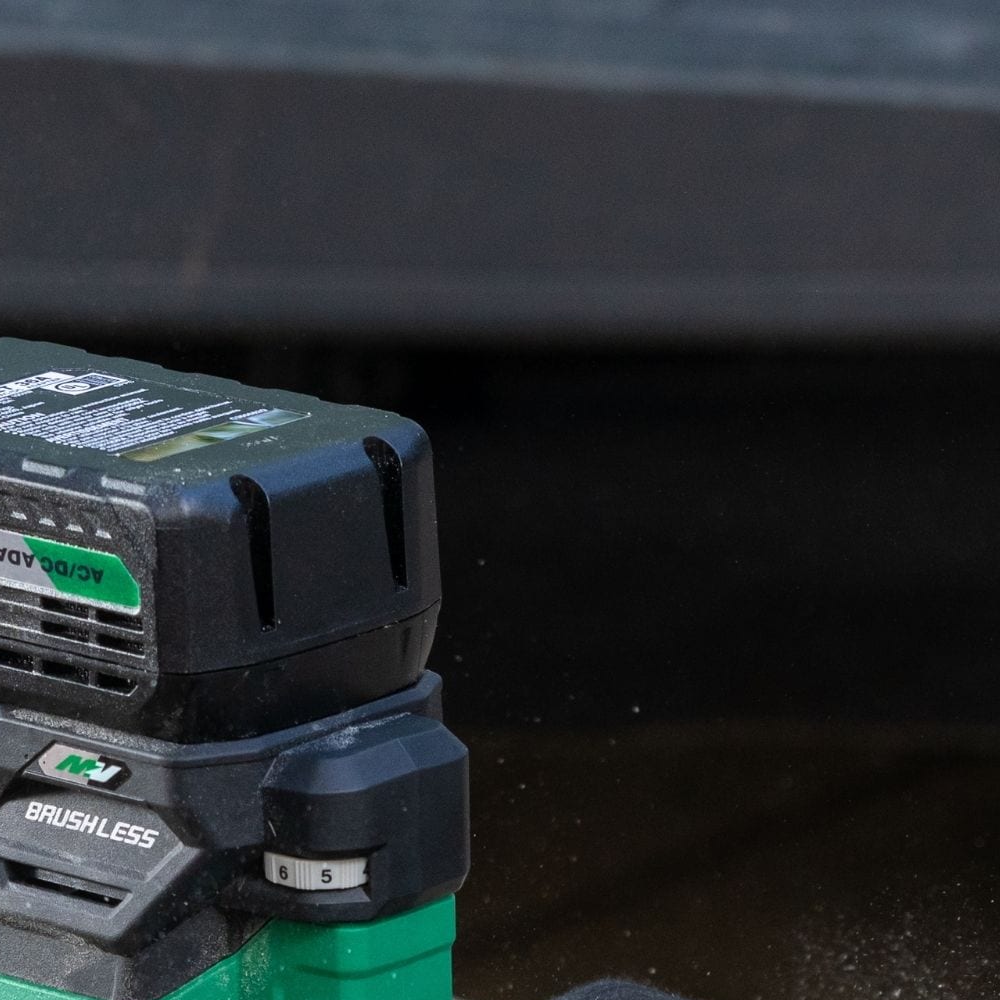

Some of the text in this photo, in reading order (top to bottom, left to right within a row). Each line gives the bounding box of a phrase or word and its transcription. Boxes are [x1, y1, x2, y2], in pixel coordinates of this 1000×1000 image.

[40, 556, 104, 583] AC/DC
[25, 801, 160, 849] BRUSHLESS
[279, 865, 333, 884] 6 5
